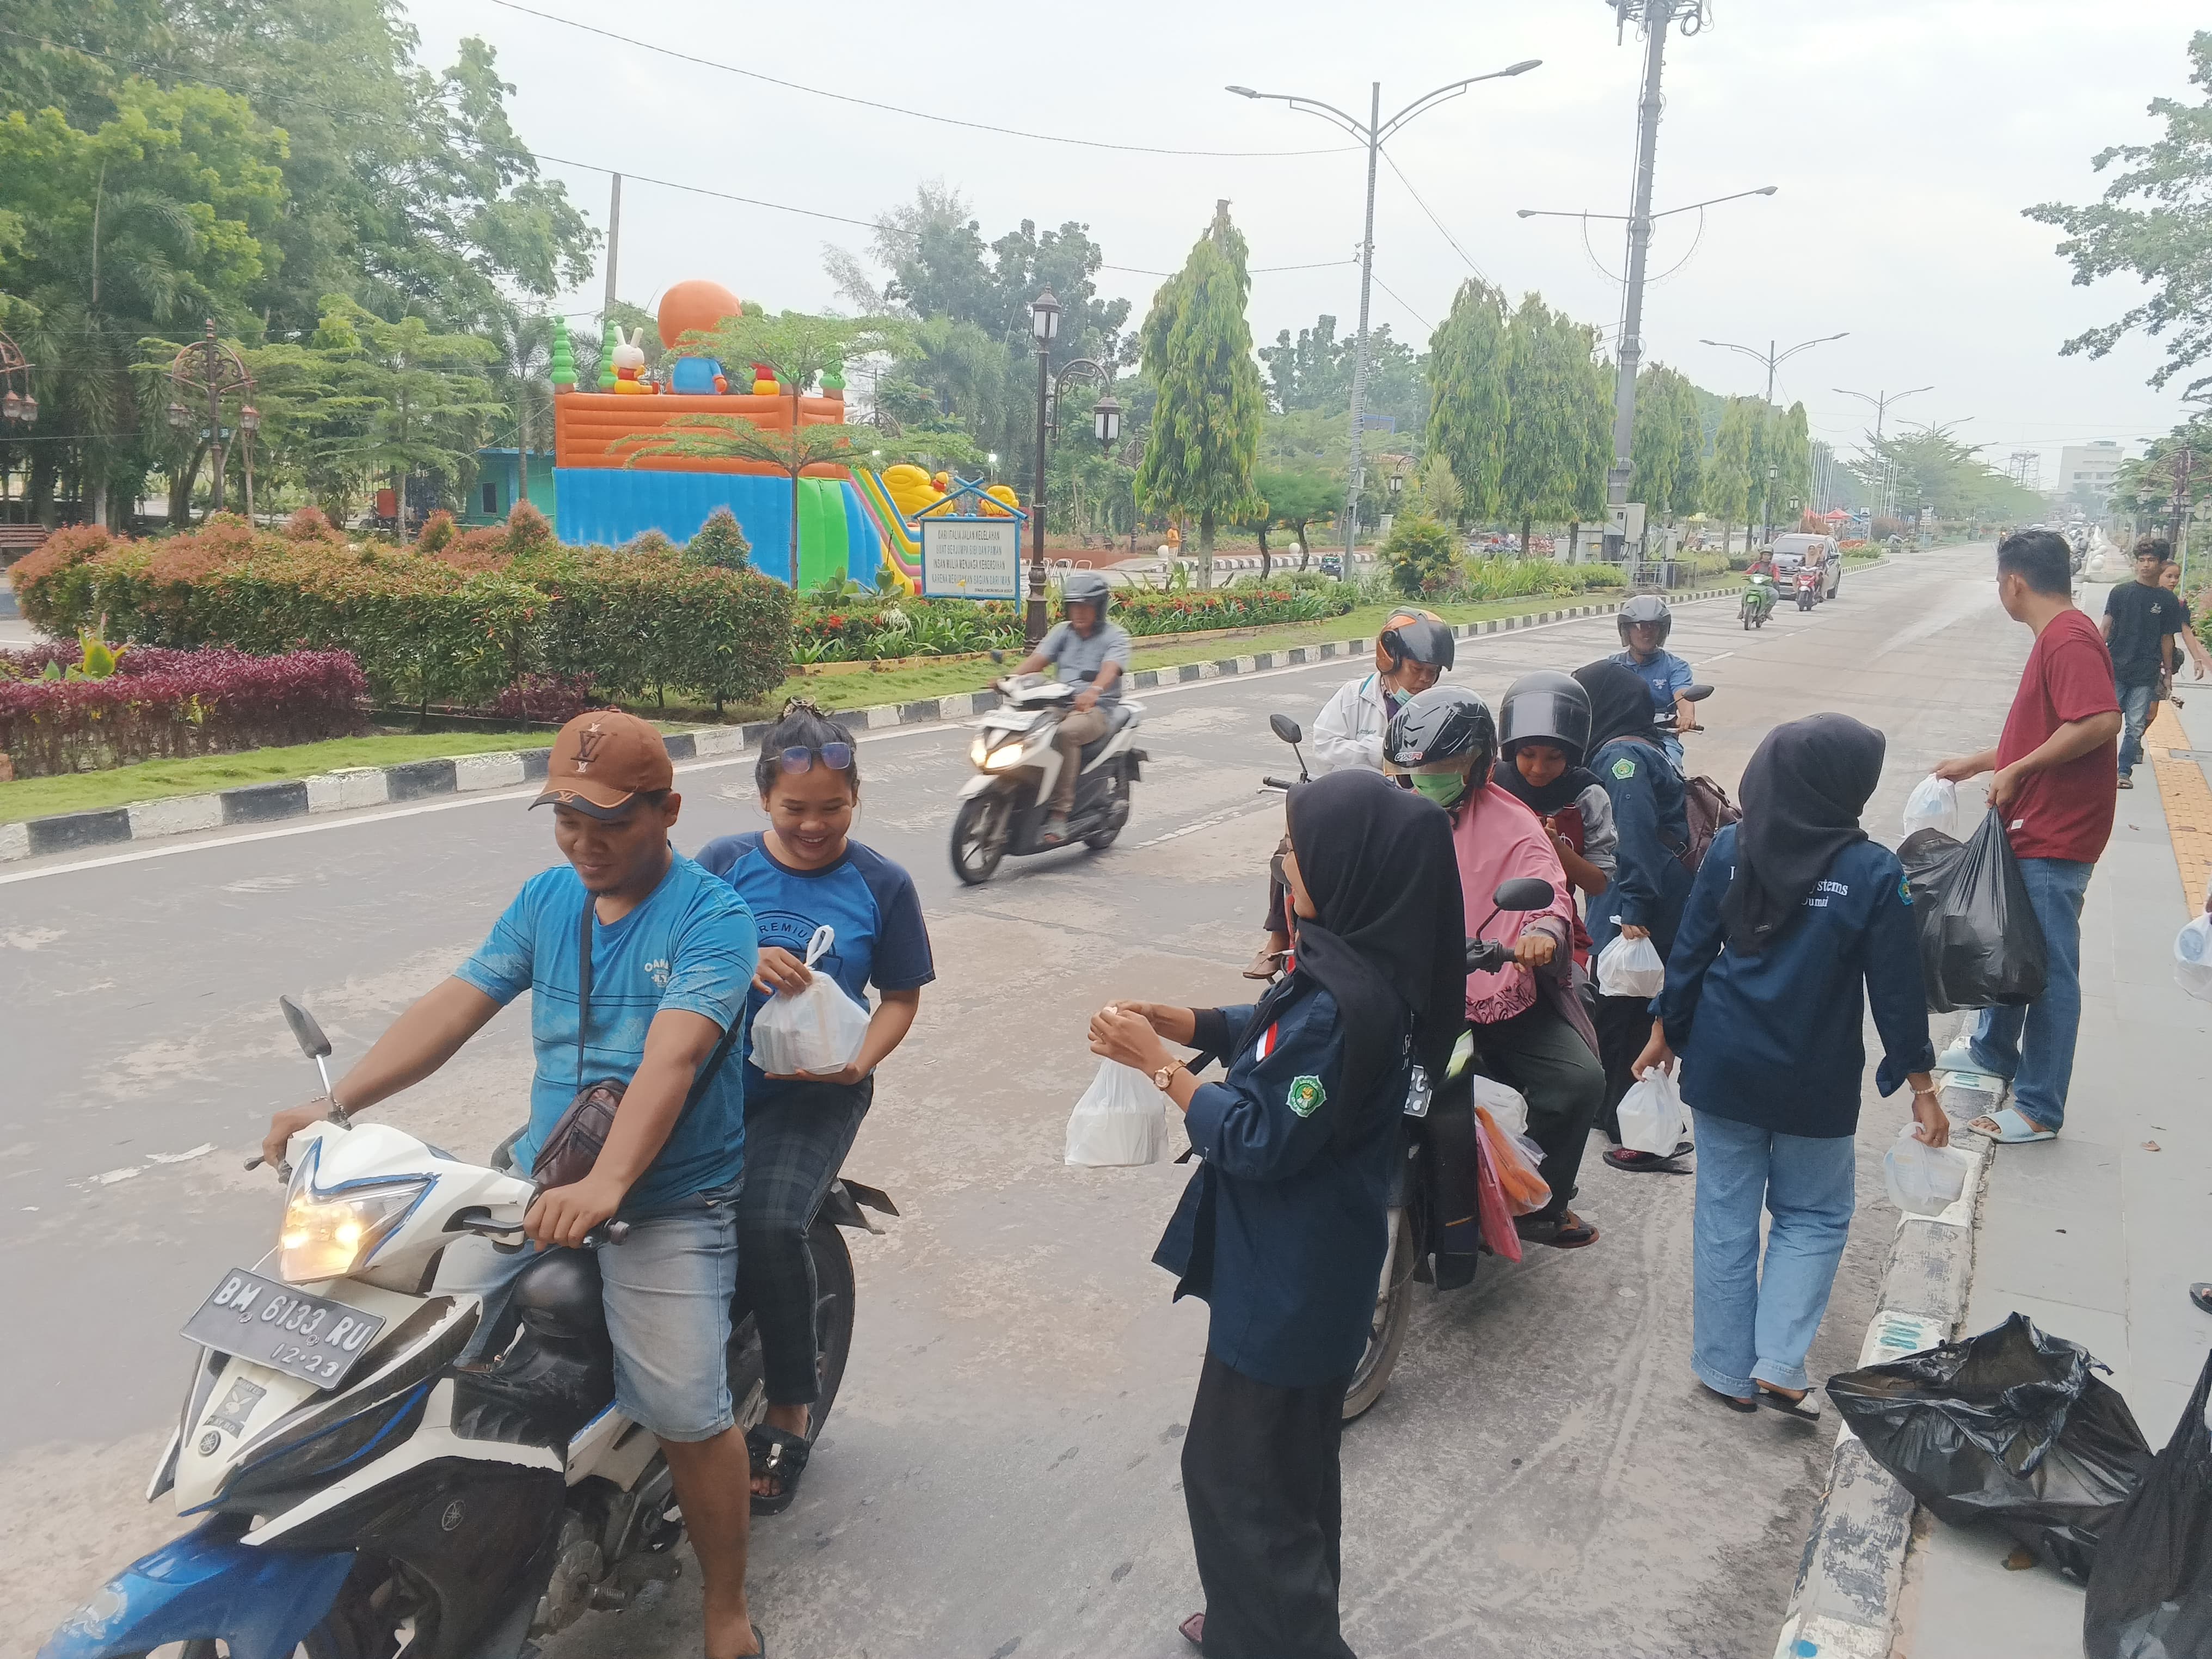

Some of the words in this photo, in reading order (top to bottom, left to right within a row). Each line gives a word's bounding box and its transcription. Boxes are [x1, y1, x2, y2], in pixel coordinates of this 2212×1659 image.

[938, 530, 948, 539] DARI
[962, 531, 974, 540] JALAN
[978, 545, 987, 555] DAN
[933, 559, 945, 568] INSAN
[947, 559, 958, 569] MULIA
[931, 574, 948, 583] KARENA
[213, 1276, 263, 1312] BM
[261, 1295, 327, 1335] 6133
[324, 1316, 372, 1351] RU
